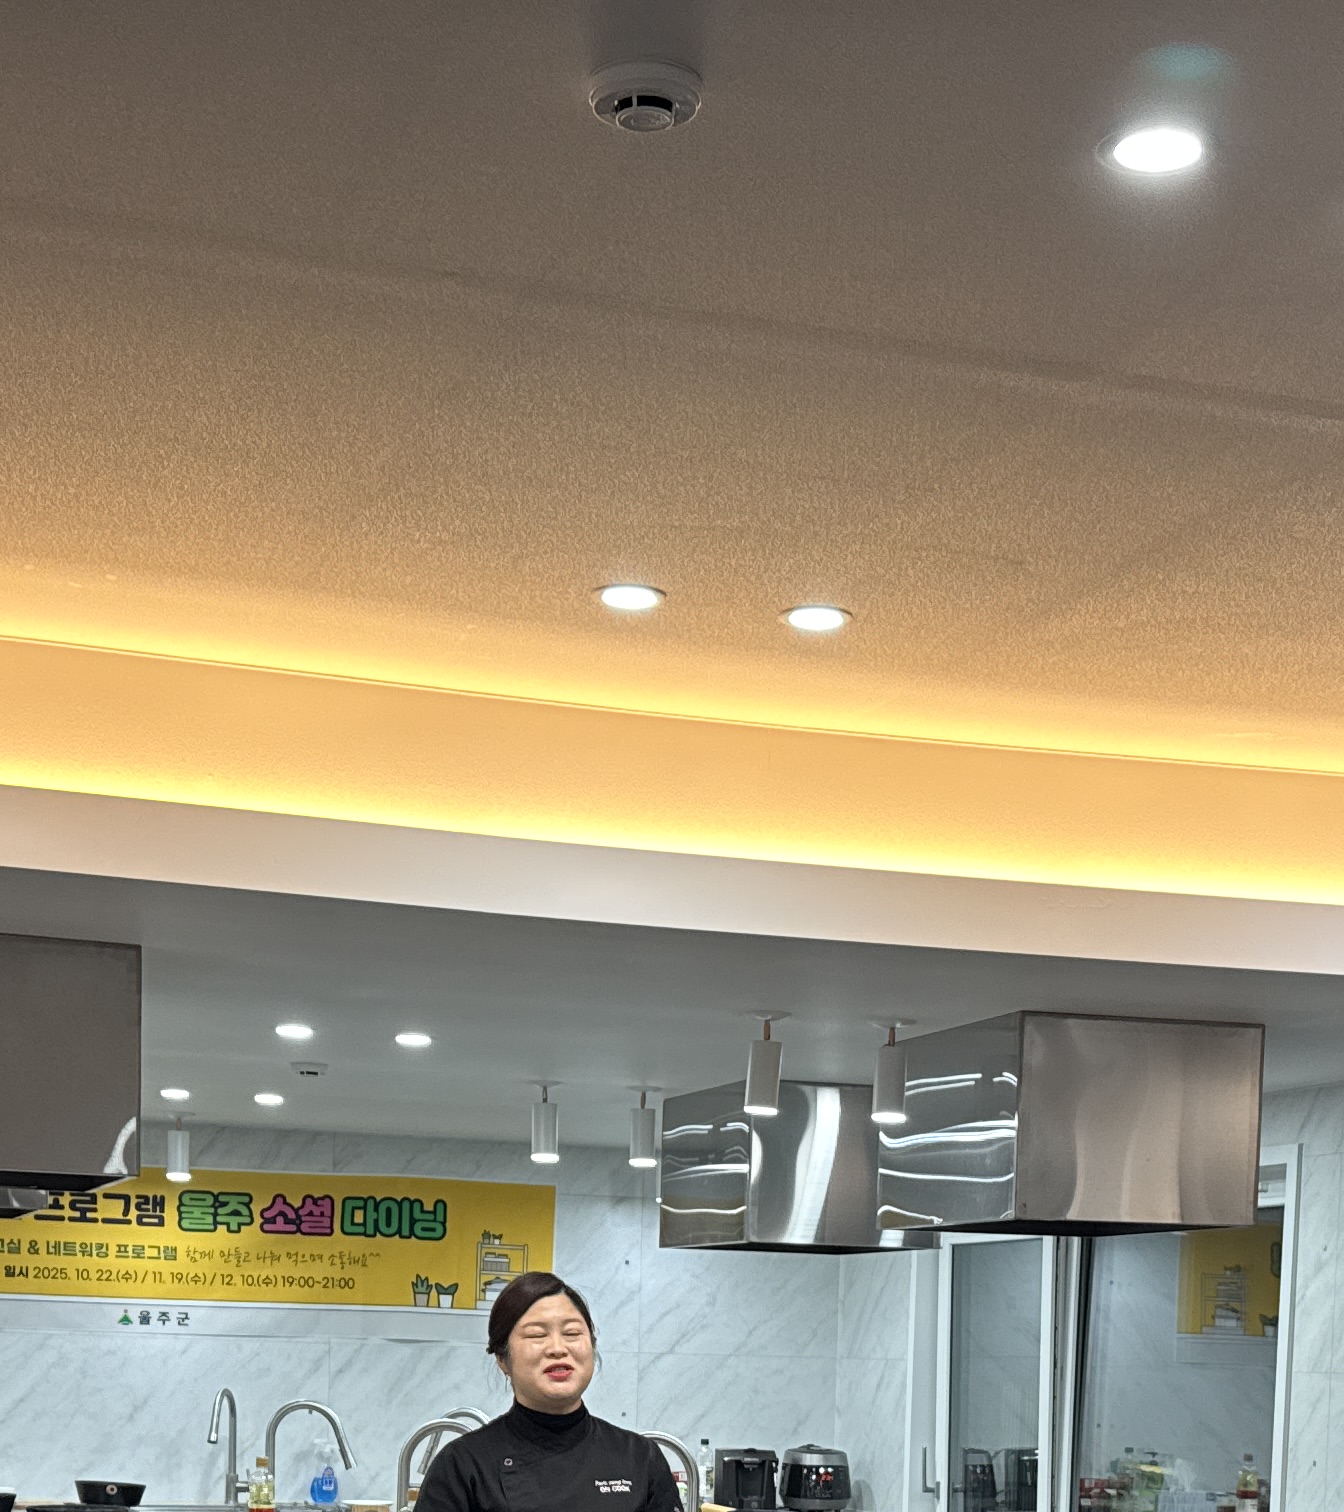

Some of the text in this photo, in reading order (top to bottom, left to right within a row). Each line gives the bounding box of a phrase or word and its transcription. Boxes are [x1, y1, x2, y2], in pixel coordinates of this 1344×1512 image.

[34, 1190, 447, 1241] 프로그램 울주 소셜 다이닝
[27, 1239, 40, 1256] &
[46, 1240, 109, 1259] 네트워킹
[115, 1243, 178, 1261] 프로그램
[185, 1245, 214, 1263] 함께
[219, 1246, 252, 1268] 만들고
[286, 1250, 323, 1267] 먹으며
[4, 1265, 29, 1278] 일시
[32, 1266, 70, 1280] 2025.
[75, 1268, 92, 1282] 10.
[96, 1268, 138, 1283] 22.(수)
[152, 1271, 166, 1284] 11.
[170, 1271, 206, 1286] 19.(수)
[221, 1273, 237, 1287] 12.
[241, 1274, 278, 1288] 10.(수)
[281, 1275, 355, 1290] 19:00~21:00
[138, 1310, 191, 1326] 울주군
